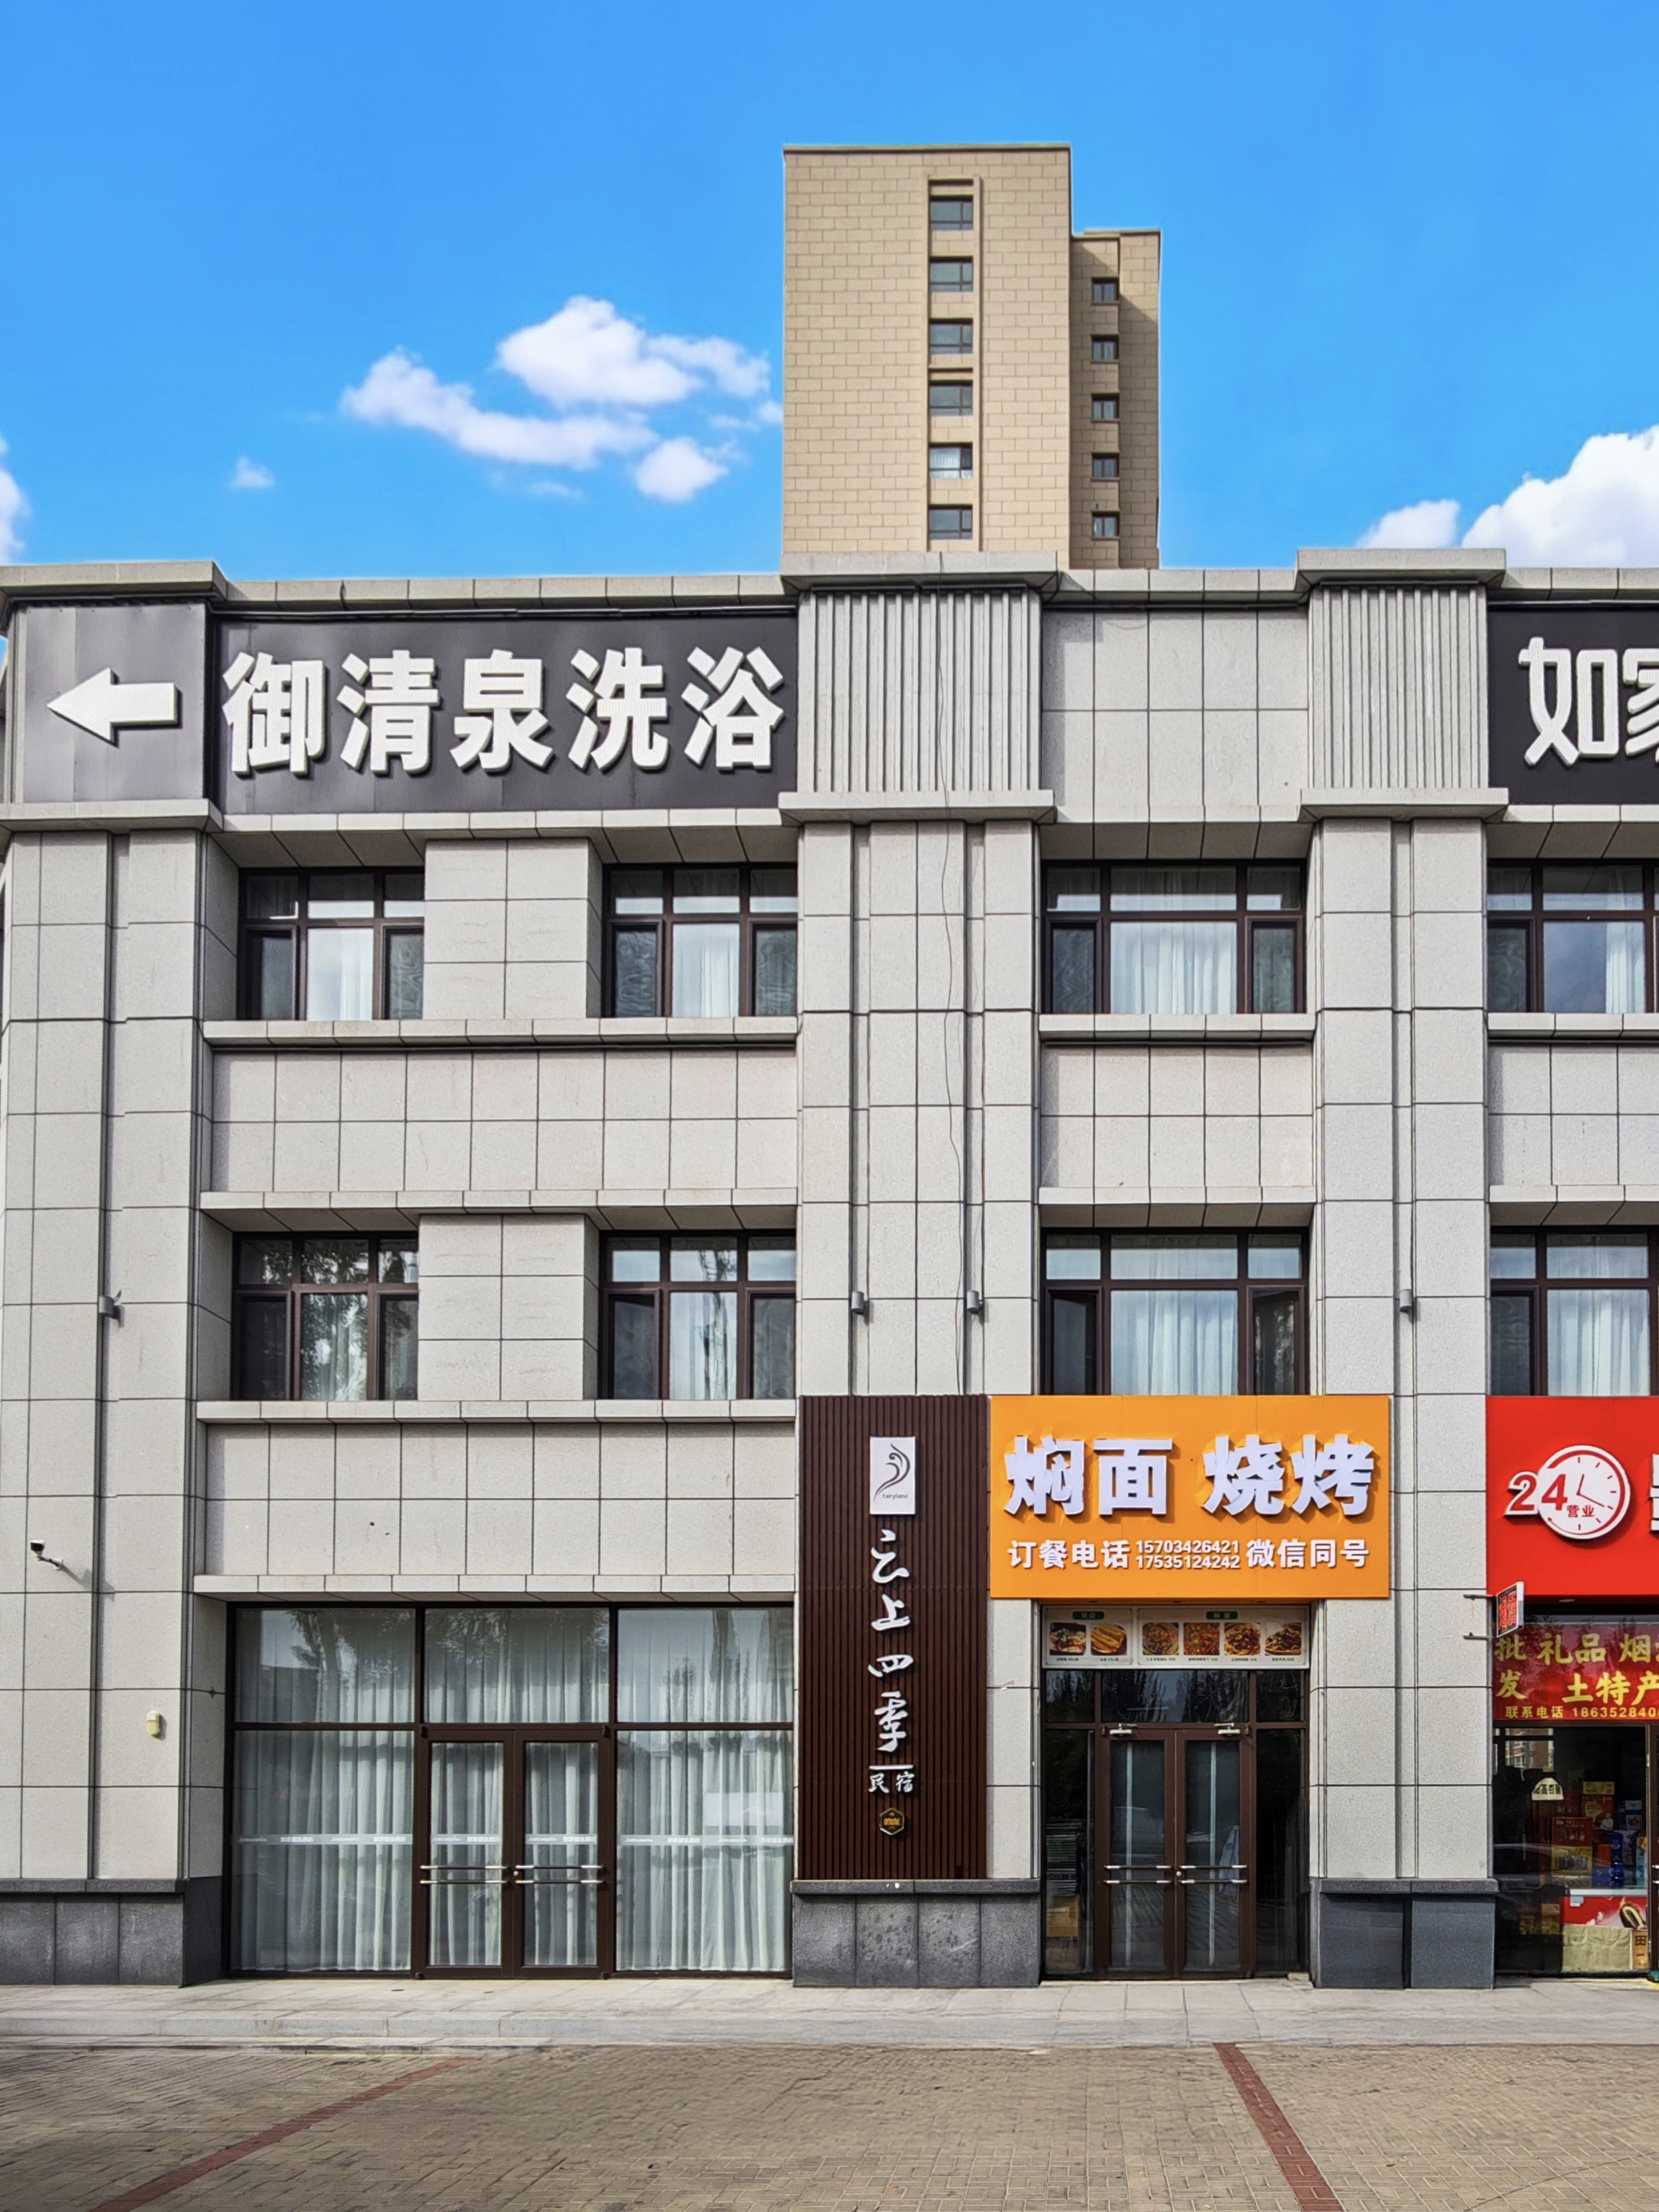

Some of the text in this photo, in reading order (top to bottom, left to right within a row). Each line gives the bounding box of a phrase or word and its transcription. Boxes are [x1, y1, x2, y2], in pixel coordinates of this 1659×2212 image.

[222, 646, 784, 776] 御清泉洗浴
[1004, 1434, 1375, 1515] 焖面 烧烤
[1509, 1473, 1568, 1511] 24
[1567, 1504, 1595, 1518] 营业
[1008, 1539, 1131, 1570] 订餐电话
[1136, 1540, 1240, 1554] 15703426421
[1136, 1555, 1241, 1569] 17535124242
[1246, 1539, 1370, 1569] 微信同号
[1619, 1633, 1659, 1663] 烟
[1562, 1671, 1659, 1707] 土特产
[1505, 1706, 1659, 1719] 联系电话 186352840
[868, 1771, 914, 1794] 民宿
